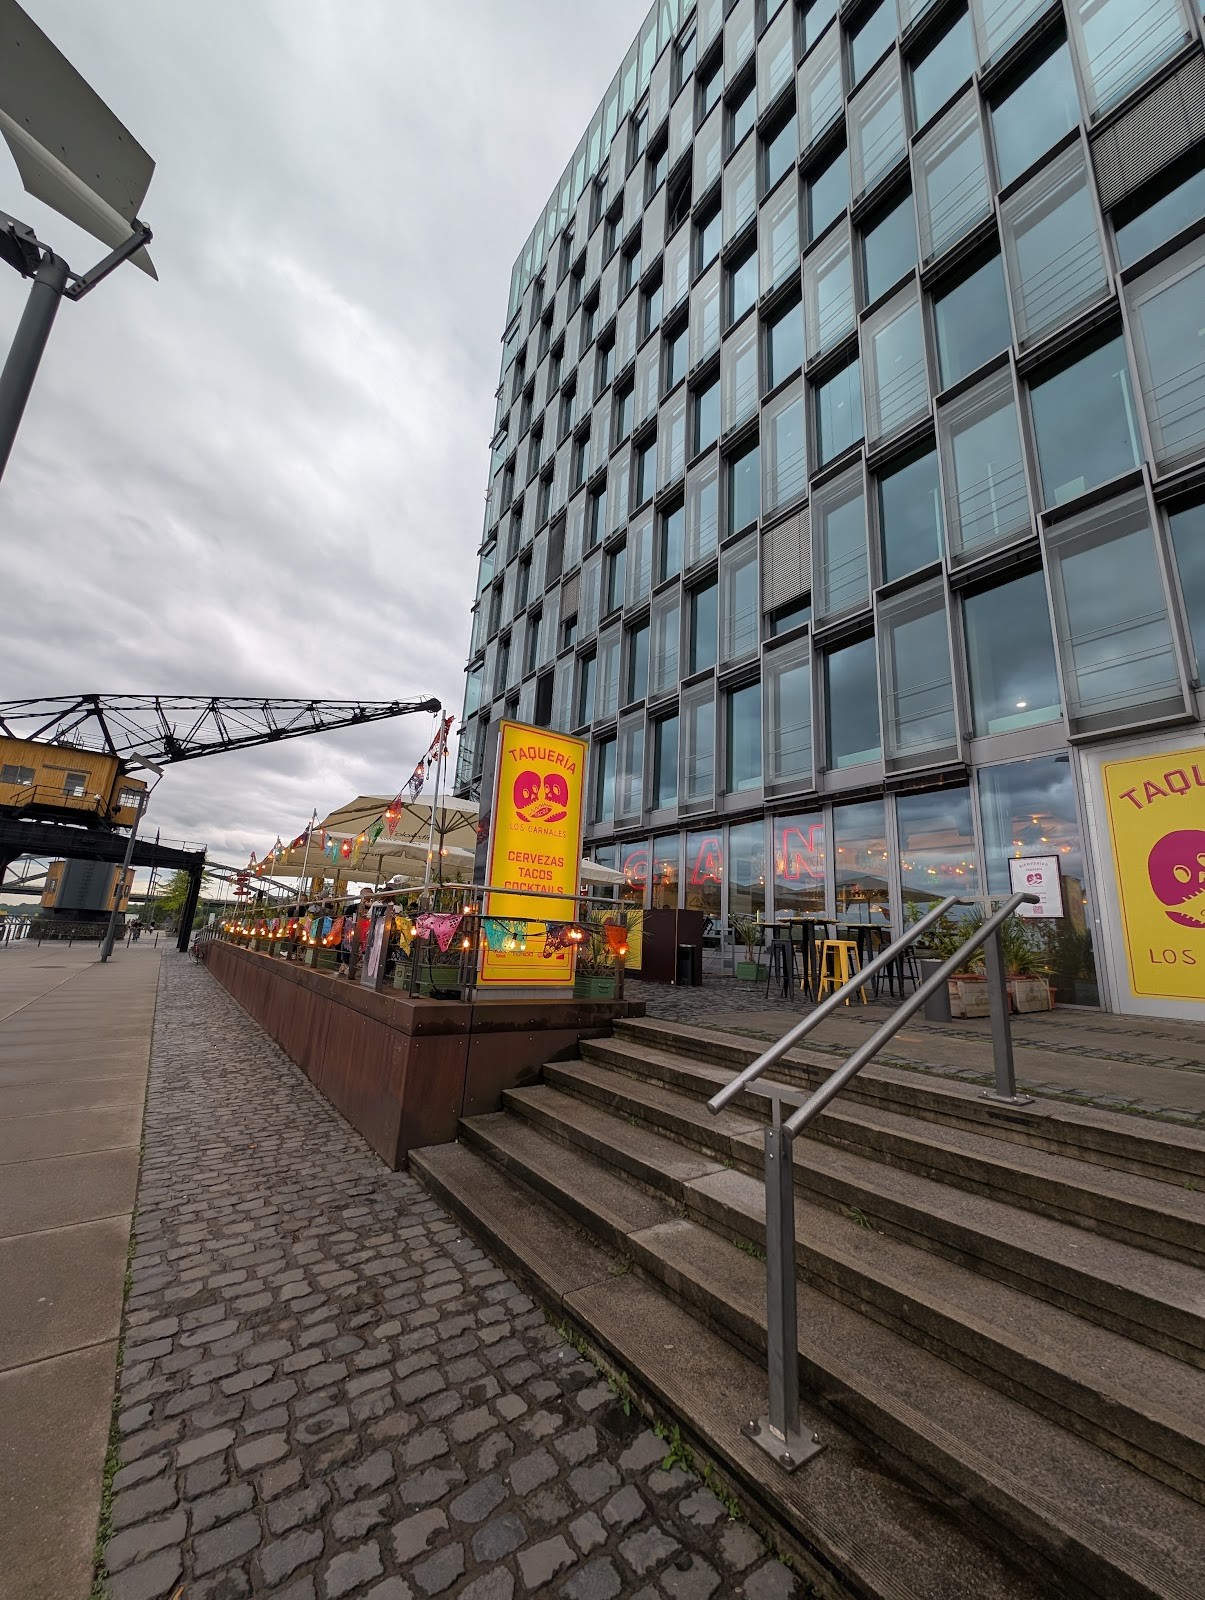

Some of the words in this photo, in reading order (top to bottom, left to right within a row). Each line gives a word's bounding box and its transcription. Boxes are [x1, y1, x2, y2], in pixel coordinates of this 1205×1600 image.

[508, 746, 576, 774] TAQUERÍA
[509, 823, 524, 831] LOS
[528, 825, 566, 838] CARNALES
[508, 850, 564, 867] CERVEZAS
[518, 867, 553, 880] TACOS
[504, 881, 564, 894] COCKTAILS
[1149, 948, 1197, 965] LOS
